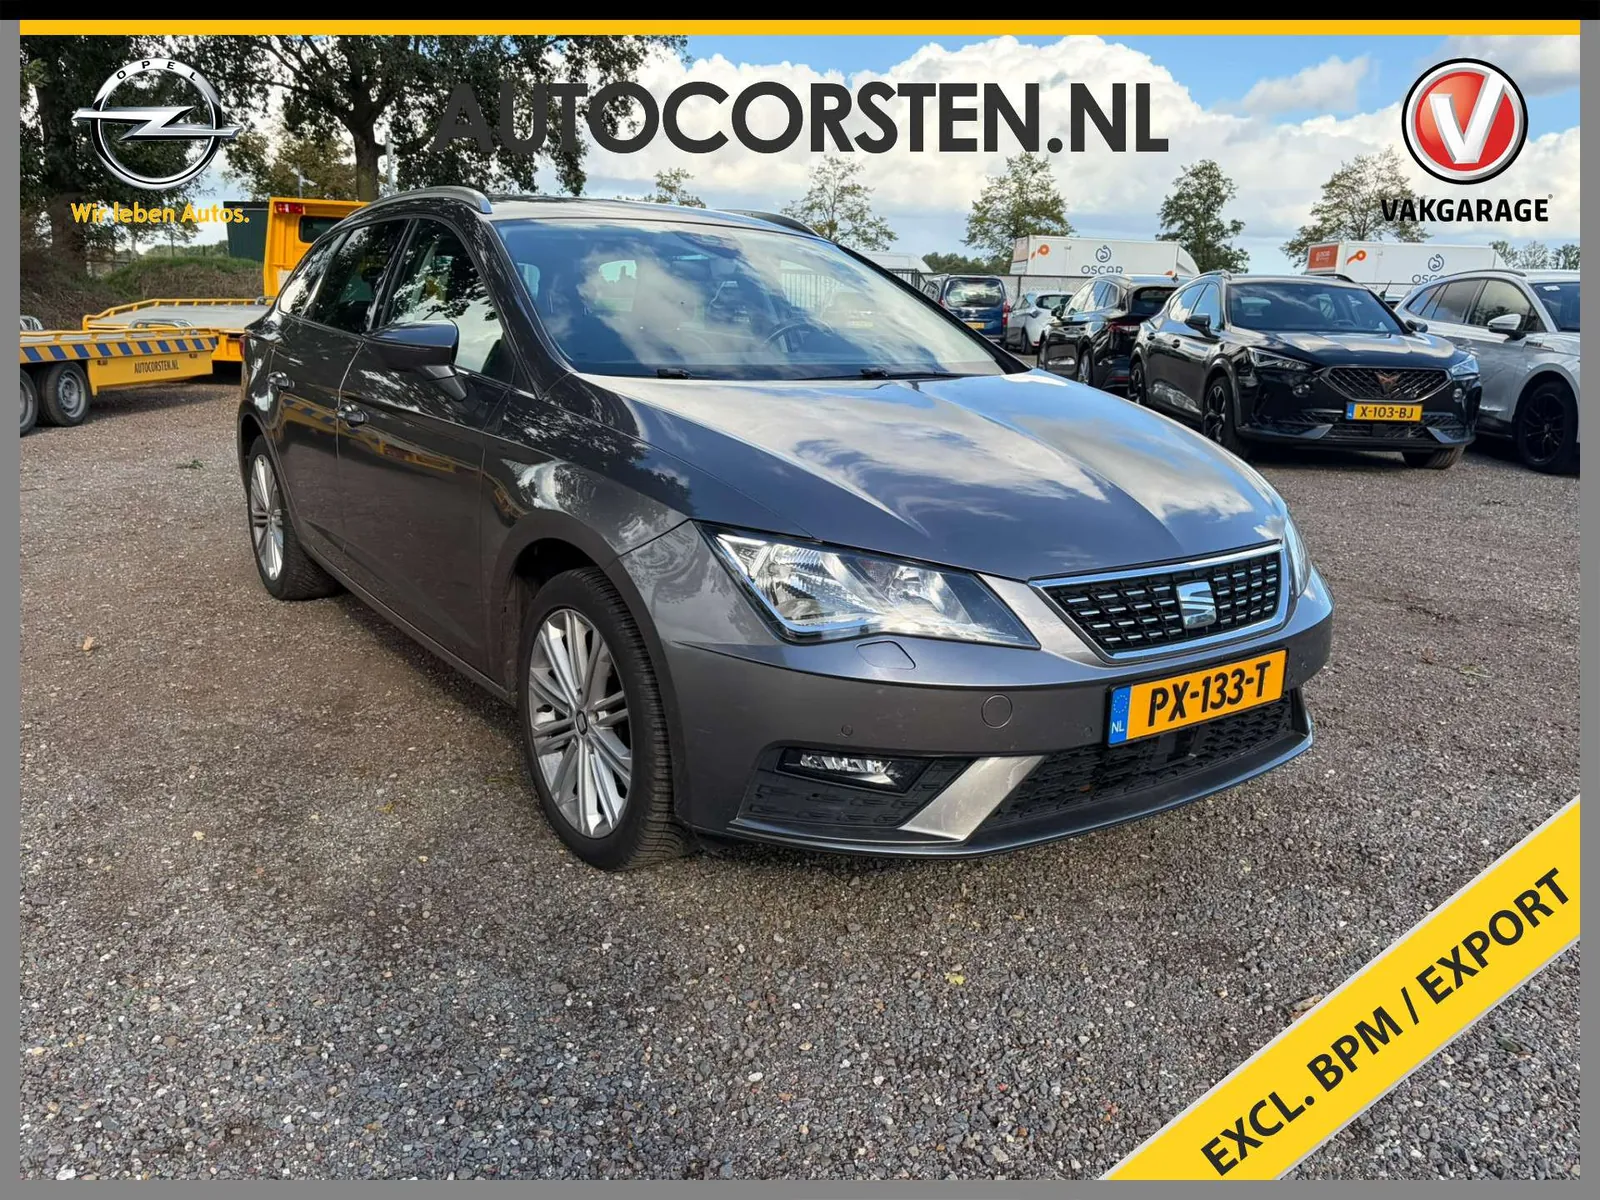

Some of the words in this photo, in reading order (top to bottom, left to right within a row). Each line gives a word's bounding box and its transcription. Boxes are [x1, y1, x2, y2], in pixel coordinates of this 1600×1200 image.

[1081, 265, 1123, 275] OSCAR
[134, 360, 179, 373] AUTOCORSTEN.NL
[1360, 405, 1414, 419] X-103-BJ
[1147, 660, 1271, 727] PX-133-T
[1111, 719, 1125, 734] NL
